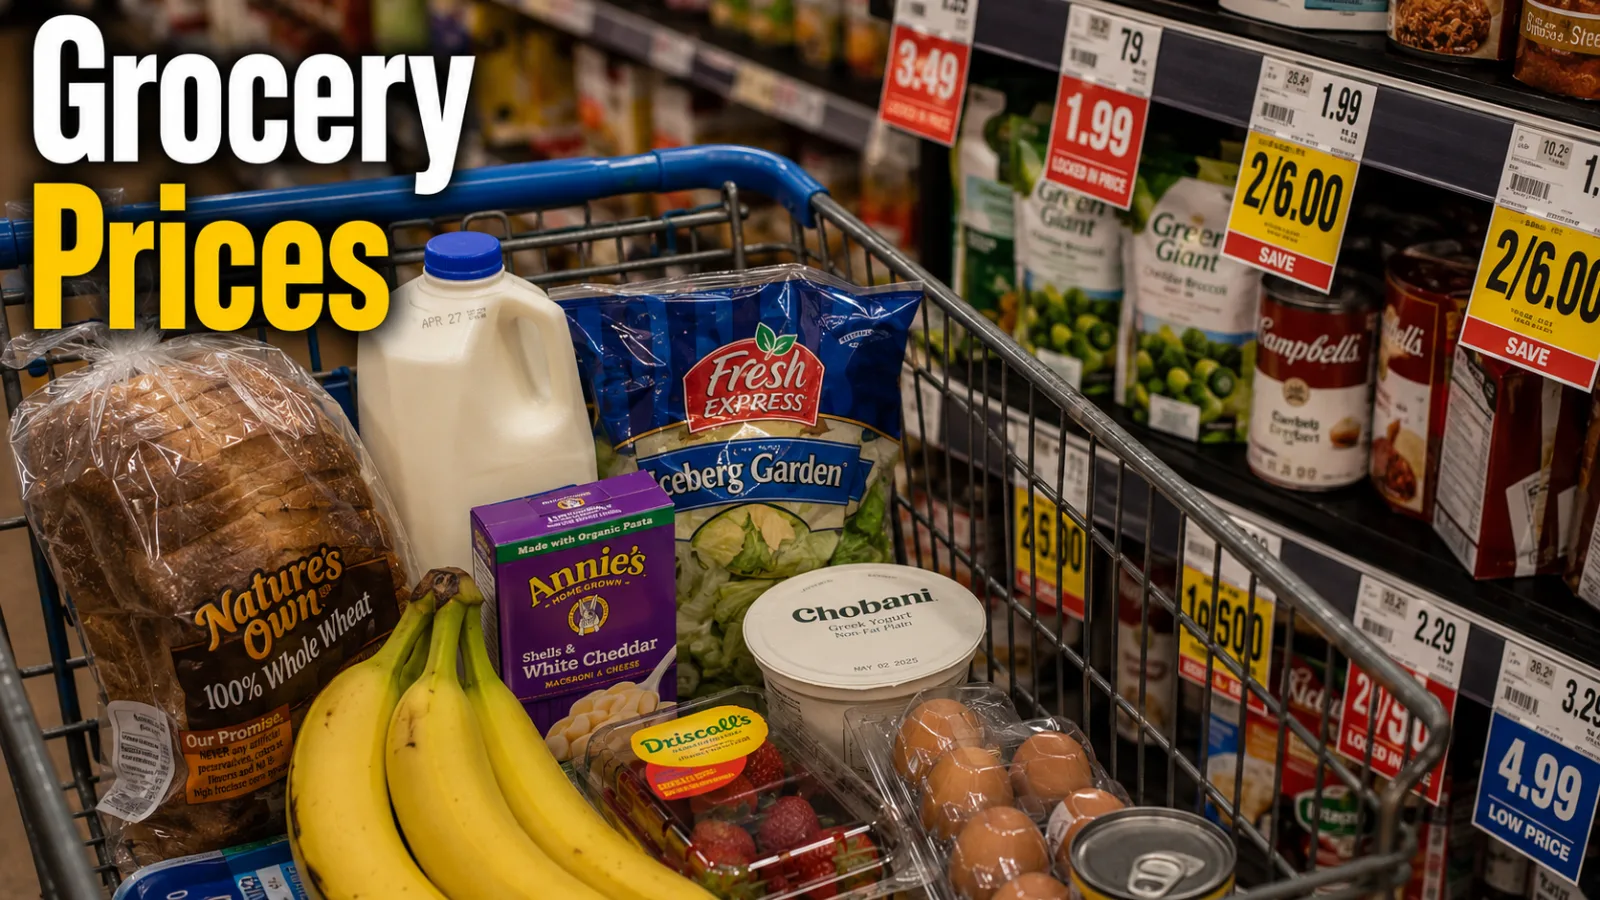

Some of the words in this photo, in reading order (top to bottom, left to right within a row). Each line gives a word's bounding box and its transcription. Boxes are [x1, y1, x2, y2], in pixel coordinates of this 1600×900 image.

[896, 39, 958, 100] 3.49
[1321, 83, 1362, 125] 1.99
[1066, 92, 1133, 158] 1.99
[1052, 155, 1087, 181] LOCKED
[1086, 167, 1099, 185] IN
[1099, 171, 1128, 195] PRICE
[1243, 151, 1343, 232] 2/6.00
[1156, 240, 1220, 273] Giant
[1258, 247, 1296, 273] SAVE
[1485, 228, 1600, 323] 2/6.00
[422, 316, 443, 329] APR
[448, 312, 462, 325] 27
[1505, 336, 1550, 367] SAVE
[706, 350, 806, 397] Fresh
[704, 393, 805, 418] EXPRESS
[750, 453, 843, 487] Garden
[518, 543, 548, 555] Made
[551, 535, 575, 547] with
[578, 526, 621, 540] Organic
[623, 517, 653, 531] Pasta
[528, 545, 646, 608] Annie's
[195, 548, 342, 651] Nature's
[792, 588, 934, 623] Chobani
[244, 589, 323, 660] Own
[829, 621, 866, 631] Greek
[869, 611, 912, 626] Yogurt
[835, 627, 881, 638] Non-Fat
[884, 621, 913, 631] Plain
[1414, 610, 1456, 654] 2.29
[203, 672, 263, 710] 100%
[262, 636, 320, 690] Whole
[317, 591, 373, 648] Wheat
[522, 647, 562, 663] Shells
[565, 643, 576, 654] &
[522, 658, 578, 679] White
[583, 638, 658, 666] Cheddar
[853, 664, 873, 672] MAY
[893, 657, 919, 666] 2025
[186, 734, 214, 748] Our
[640, 715, 752, 753] Driscoll's
[1346, 730, 1388, 761] LOCED
[1498, 737, 1582, 821] 4.99
[1488, 803, 1524, 834] LOW
[1524, 824, 1571, 862] PRICE
